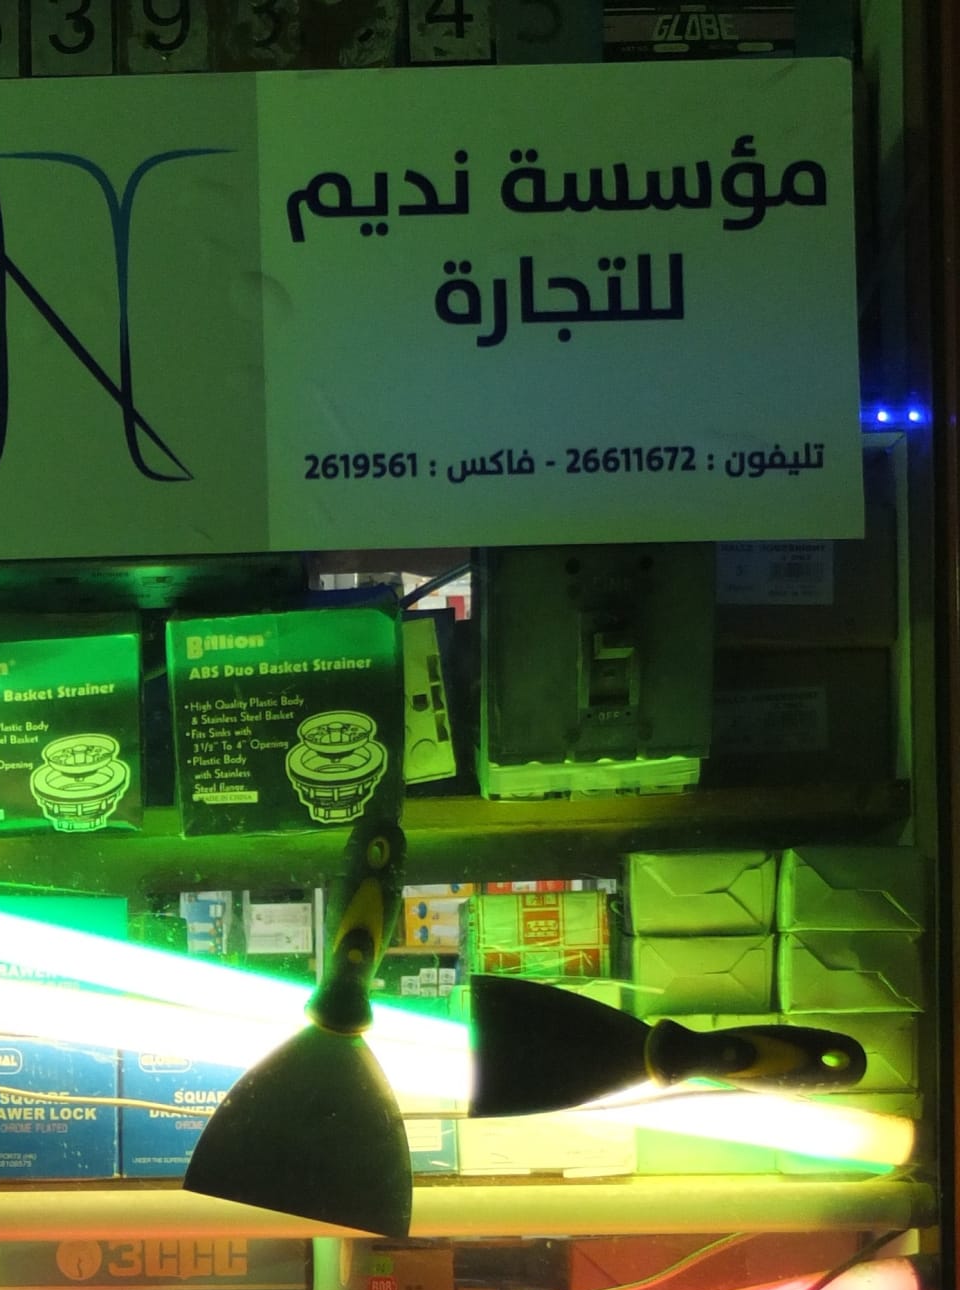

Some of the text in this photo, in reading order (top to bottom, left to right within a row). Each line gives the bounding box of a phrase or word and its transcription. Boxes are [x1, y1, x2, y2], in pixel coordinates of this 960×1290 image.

[651, 14, 739, 41] GLOBE
[286, 134, 828, 243] مؤسسة نديم
[434, 252, 685, 348] للتجارة
[304, 442, 825, 484] تليفون 26611672 فاكس 2619561
[186, 634, 265, 660] Billion
[189, 657, 373, 680] ABS Duo Basket Strainer
[4, 688, 53, 702] Basket
[57, 683, 115, 698] Strainer
[190, 695, 305, 713] High Quality Plastic Body
[200, 714, 238, 725] Stainless
[240, 712, 263, 723] Steel
[265, 711, 294, 721] Basket
[25, 720, 49, 732] Body
[10, 734, 39, 744] Basket
[191, 727, 252, 740] Fits Sinks with
[222, 741, 233, 752] To
[250, 739, 289, 751] Opening
[192, 755, 247, 767] Plastic Body
[194, 768, 251, 780] with Stainless
[194, 783, 217, 794] Steel
[173, 1090, 228, 1104] SQUAR
[50, 1107, 97, 1121] LOCK
